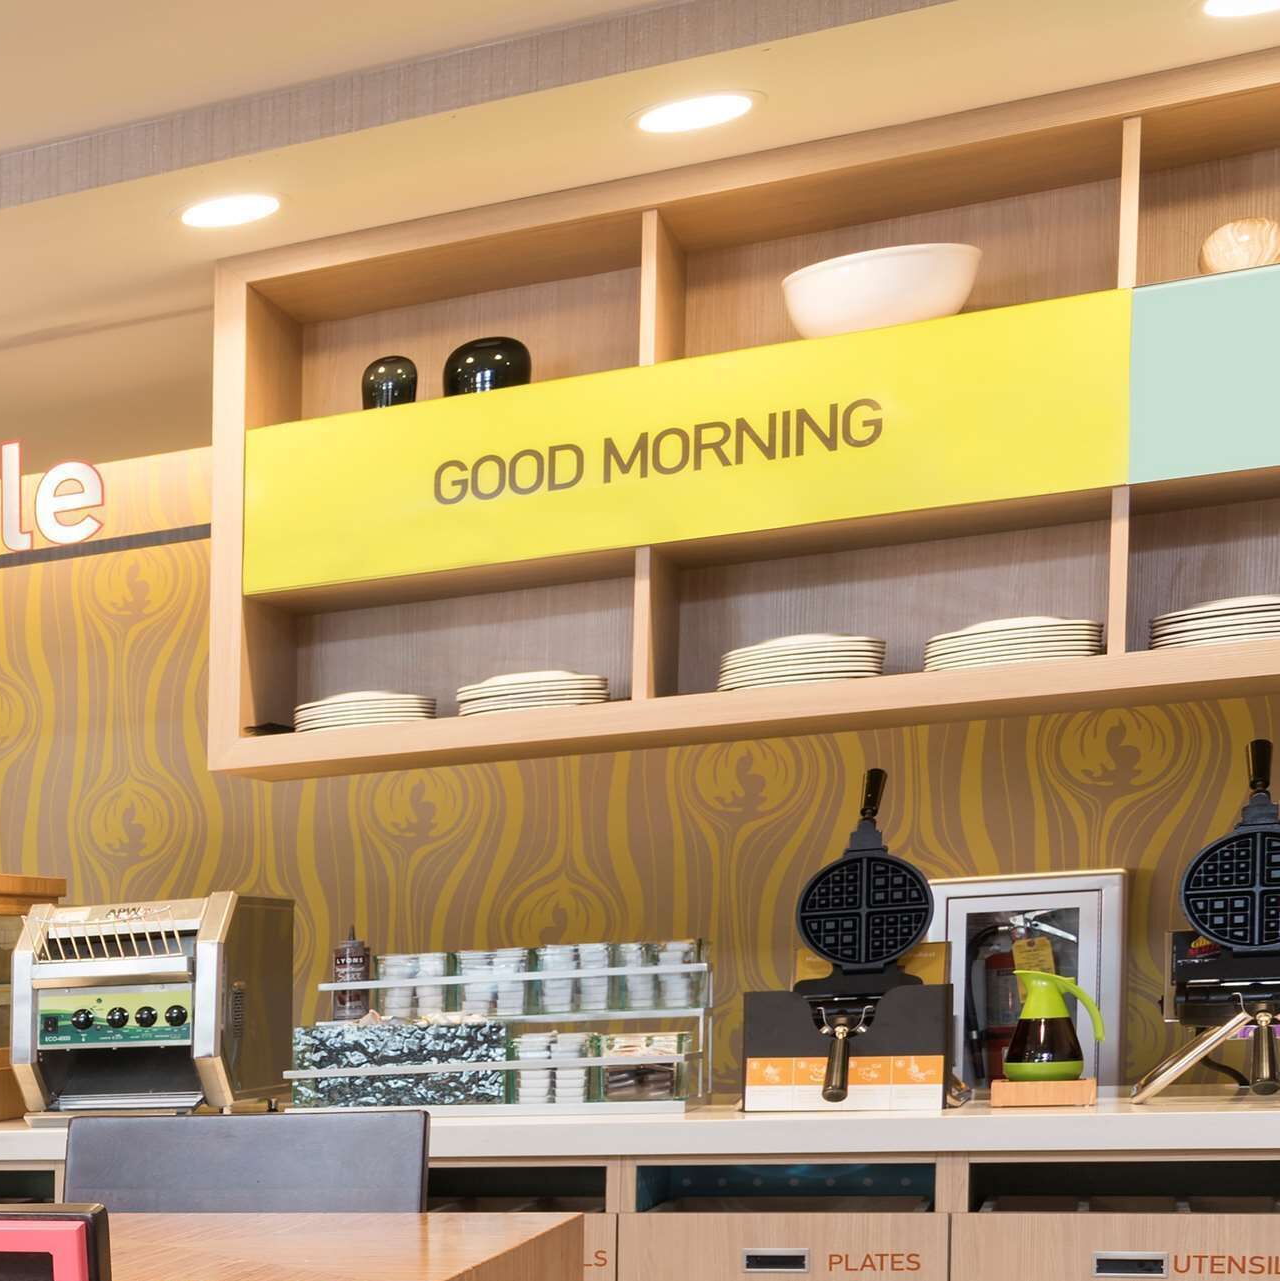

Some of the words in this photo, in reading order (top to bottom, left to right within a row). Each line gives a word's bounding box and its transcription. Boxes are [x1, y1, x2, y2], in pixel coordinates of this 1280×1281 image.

[434, 443, 584, 505] GOOD
[604, 398, 882, 484] MORNING
[828, 1253, 921, 1271] PLATES
